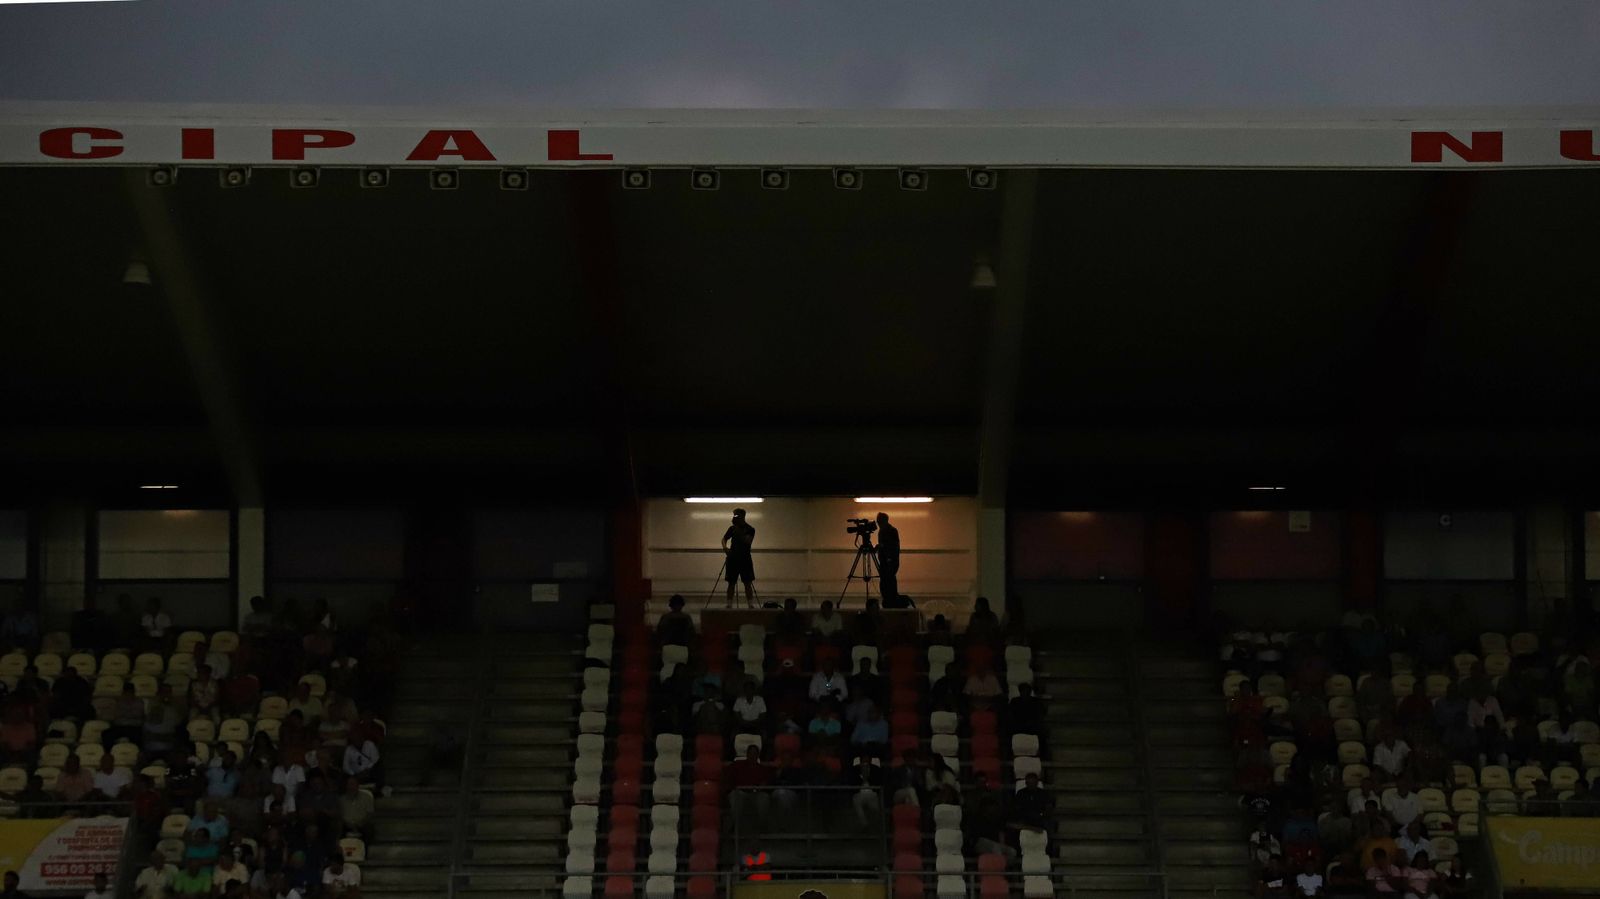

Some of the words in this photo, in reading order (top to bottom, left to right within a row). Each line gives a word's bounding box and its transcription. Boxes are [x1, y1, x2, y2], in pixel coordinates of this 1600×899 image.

[39, 127, 614, 160] CIPAL
[1499, 829, 1600, 870] Camp
[44, 864, 68, 875] 956
